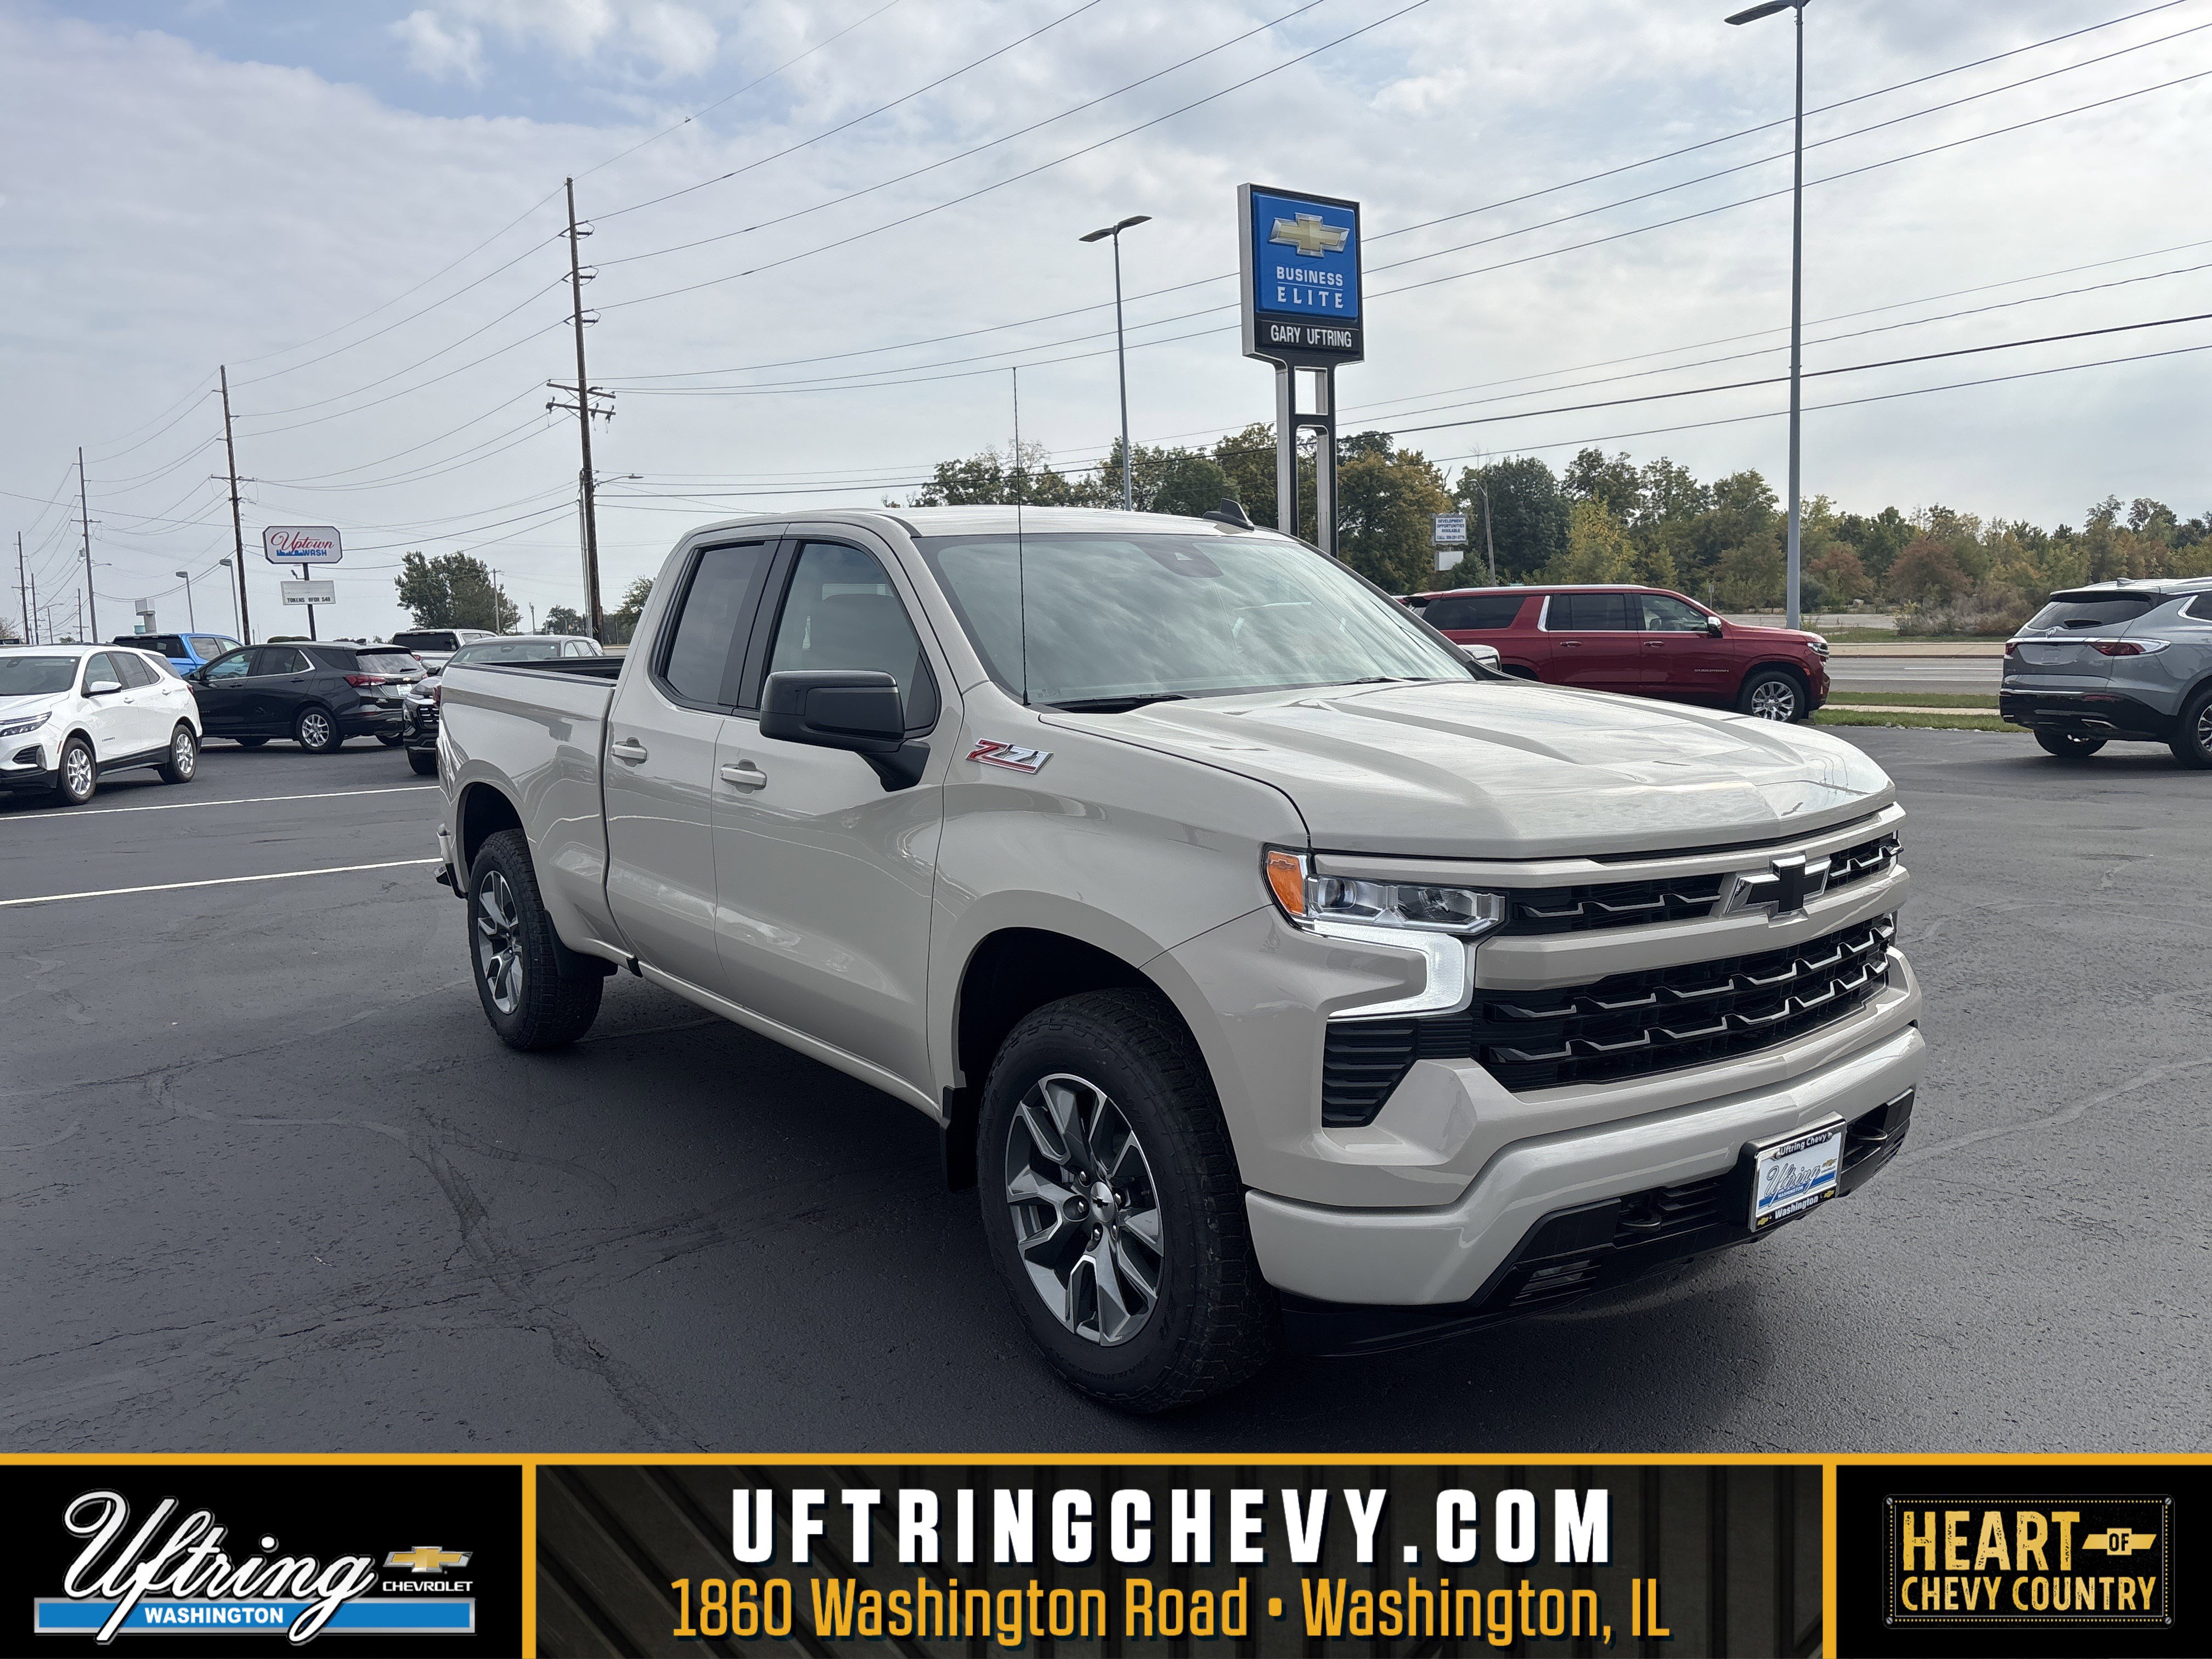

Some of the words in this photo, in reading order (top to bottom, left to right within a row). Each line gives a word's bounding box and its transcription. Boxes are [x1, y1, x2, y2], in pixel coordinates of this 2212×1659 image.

[1277, 266, 1344, 286] BUSINESS
[1277, 286, 1344, 309] ELITE
[1271, 325, 1301, 343] GARY
[1307, 328, 1352, 348] UFTRING
[270, 531, 335, 553] Uptown
[965, 737, 1054, 775] Z71
[1780, 1141, 1805, 1155] Uftring
[1807, 1133, 1827, 1146] Chevy
[1764, 1163, 1821, 1207] Uftring
[1775, 1195, 1819, 1220] Washington
